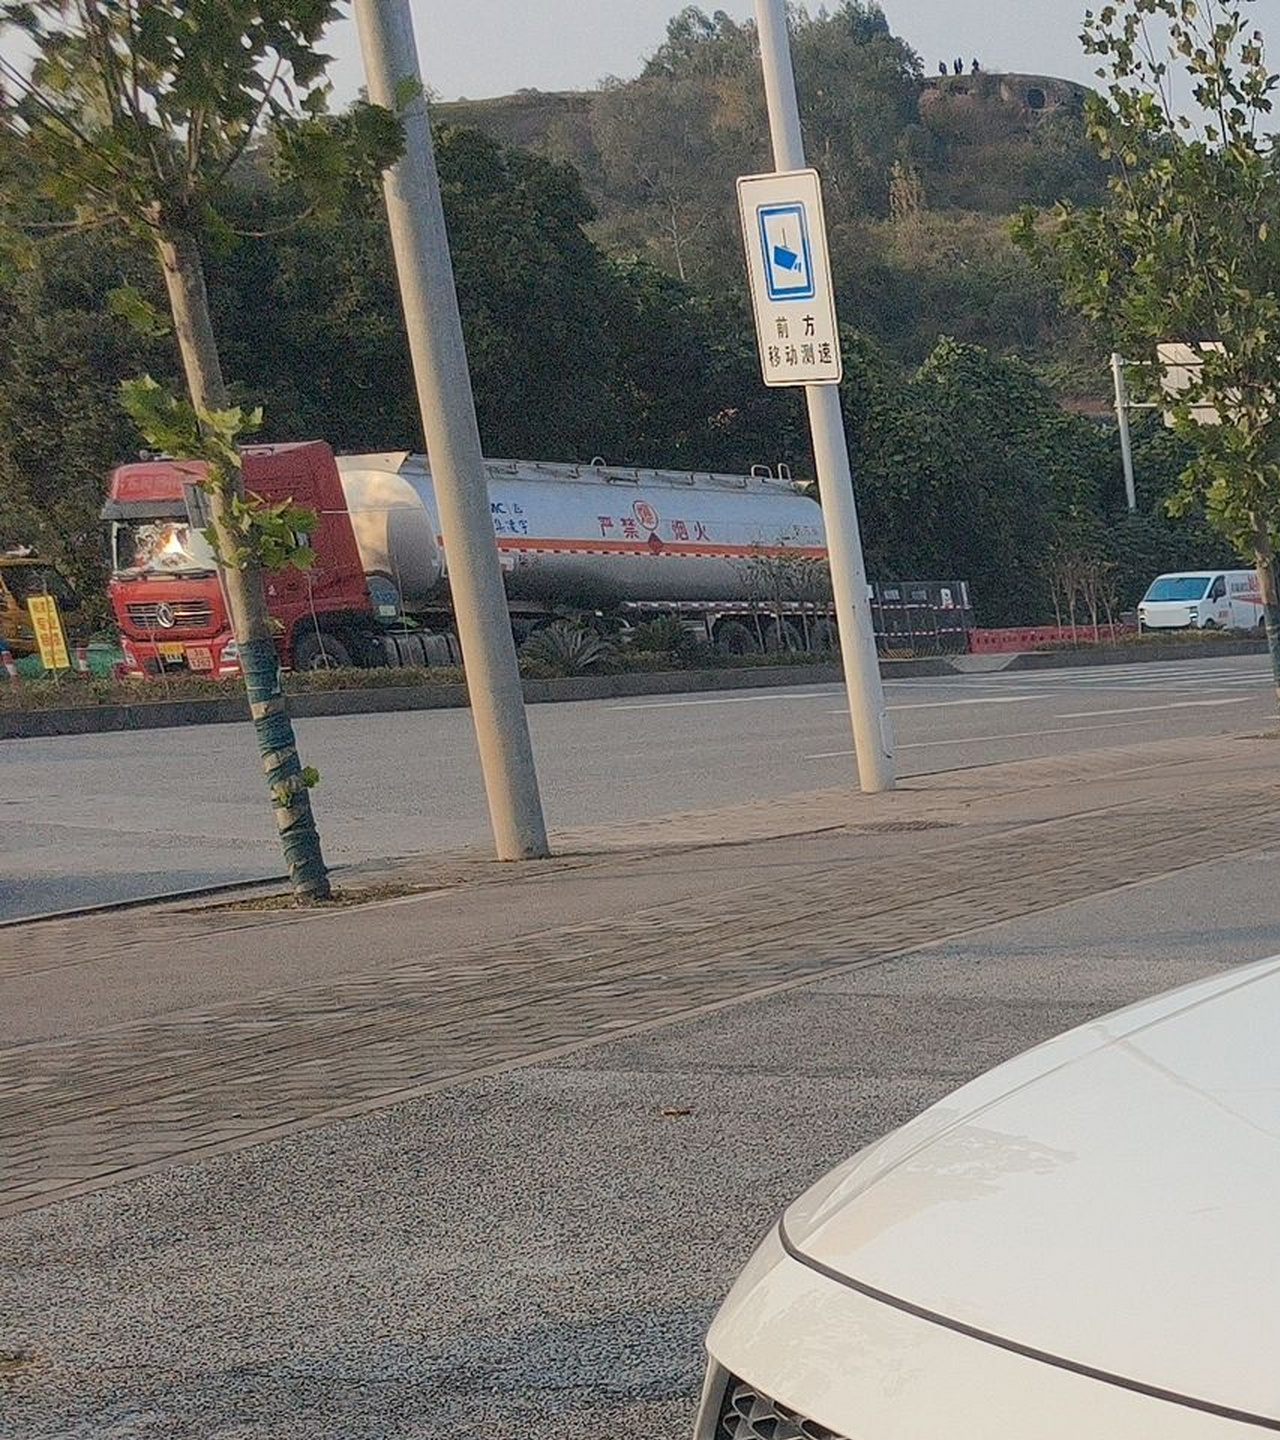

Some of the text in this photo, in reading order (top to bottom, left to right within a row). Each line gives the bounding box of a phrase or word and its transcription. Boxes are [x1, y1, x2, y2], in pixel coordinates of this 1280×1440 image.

[775, 315, 815, 339] 前方
[767, 343, 833, 367] 移动测速
